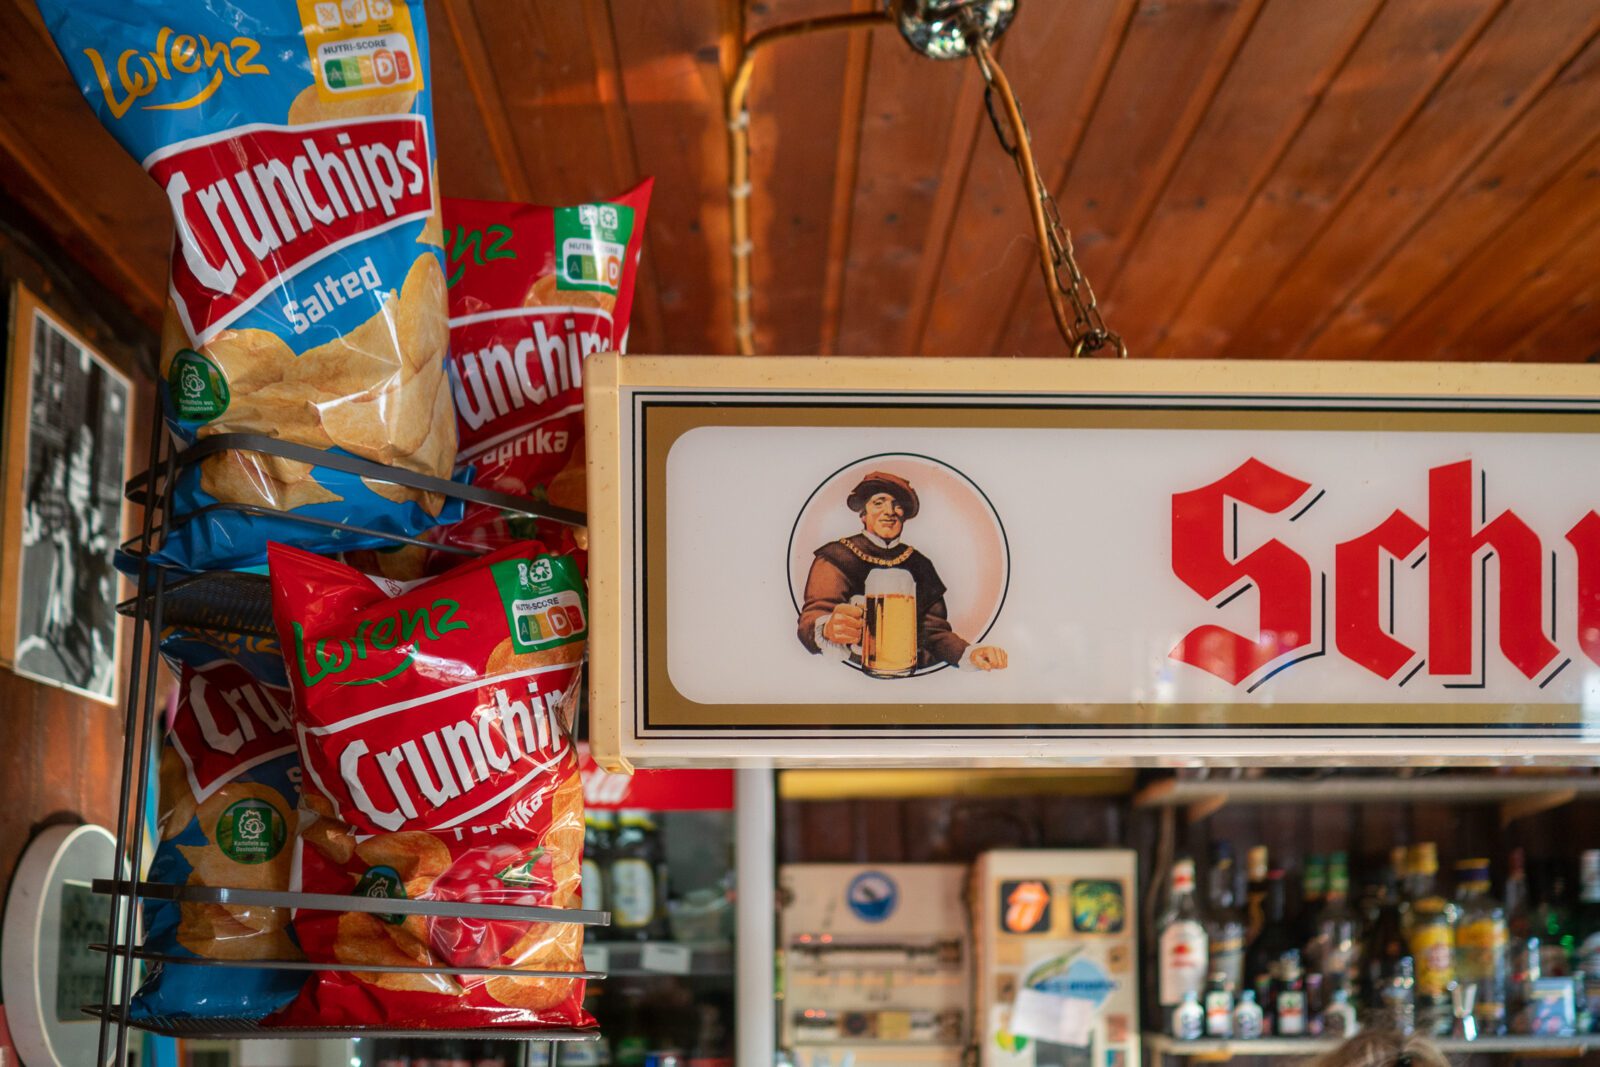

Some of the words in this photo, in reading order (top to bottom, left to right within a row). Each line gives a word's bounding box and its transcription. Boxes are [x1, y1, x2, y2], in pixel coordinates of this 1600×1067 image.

[83, 26, 270, 119] Lorenz
[323, 40, 387, 55] NUTRI-SCORE
[376, 57, 394, 78] D
[167, 132, 425, 296] Crunchips
[282, 256, 382, 337] Salted
[291, 598, 470, 687] Lorenz
[551, 613, 568, 631] D
